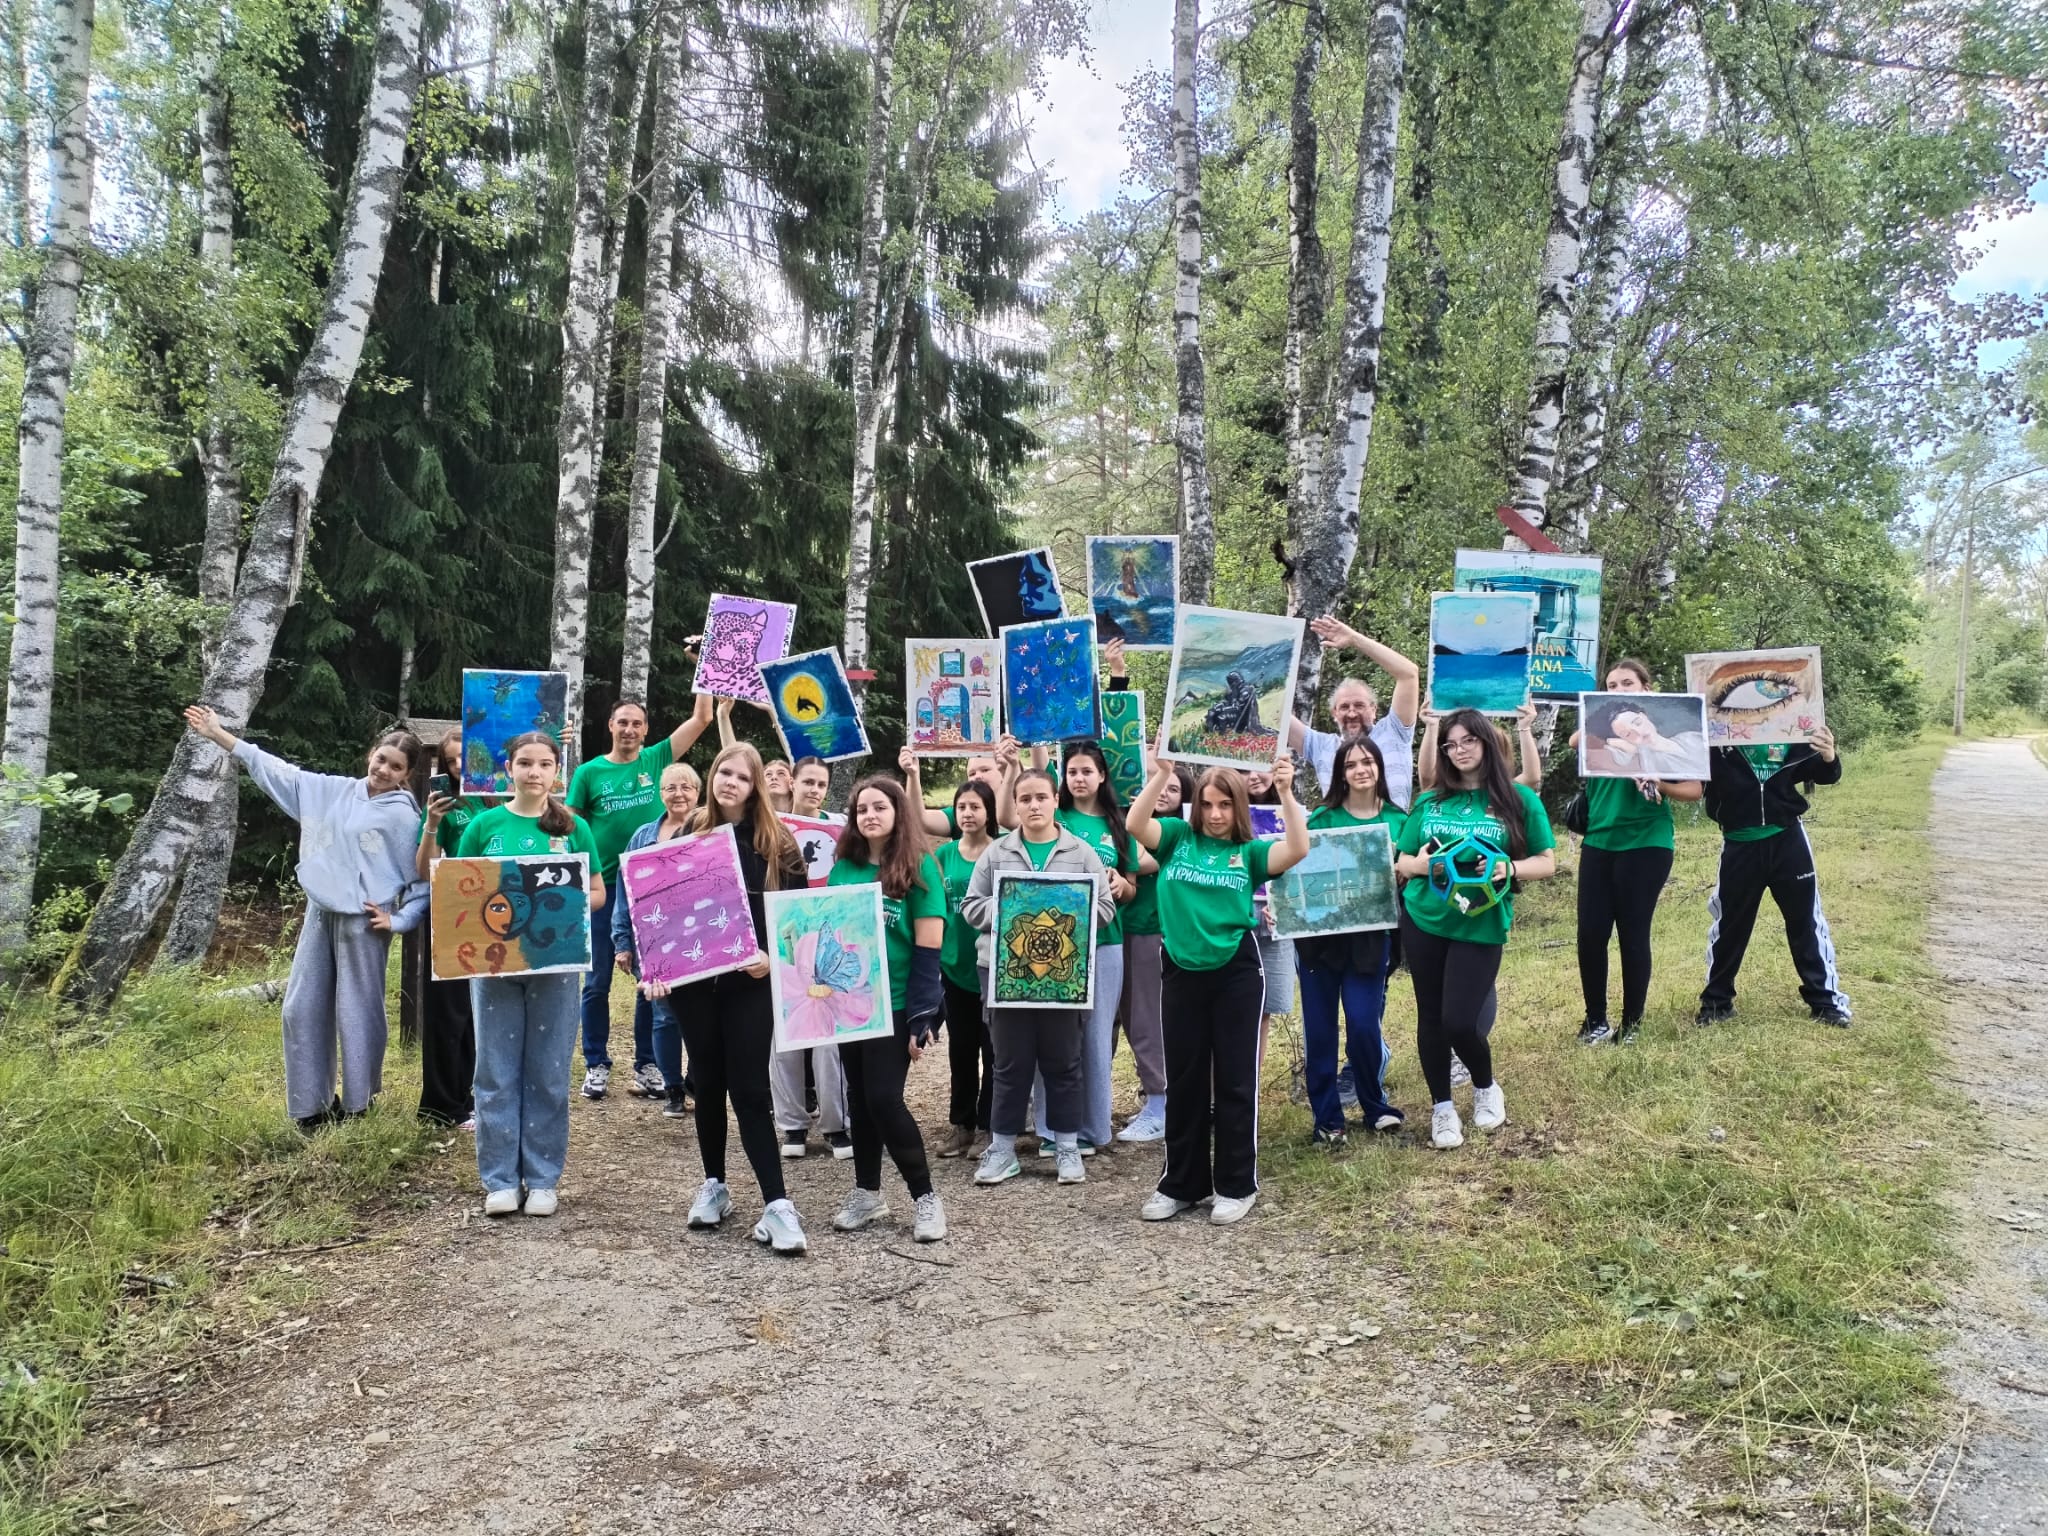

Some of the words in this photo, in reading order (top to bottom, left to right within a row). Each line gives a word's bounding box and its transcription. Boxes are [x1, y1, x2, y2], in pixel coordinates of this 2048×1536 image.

[1535, 643, 1566, 656] RAN
[1531, 659, 1563, 673] ANA
[1175, 866, 1214, 886] КРИЛИМА
